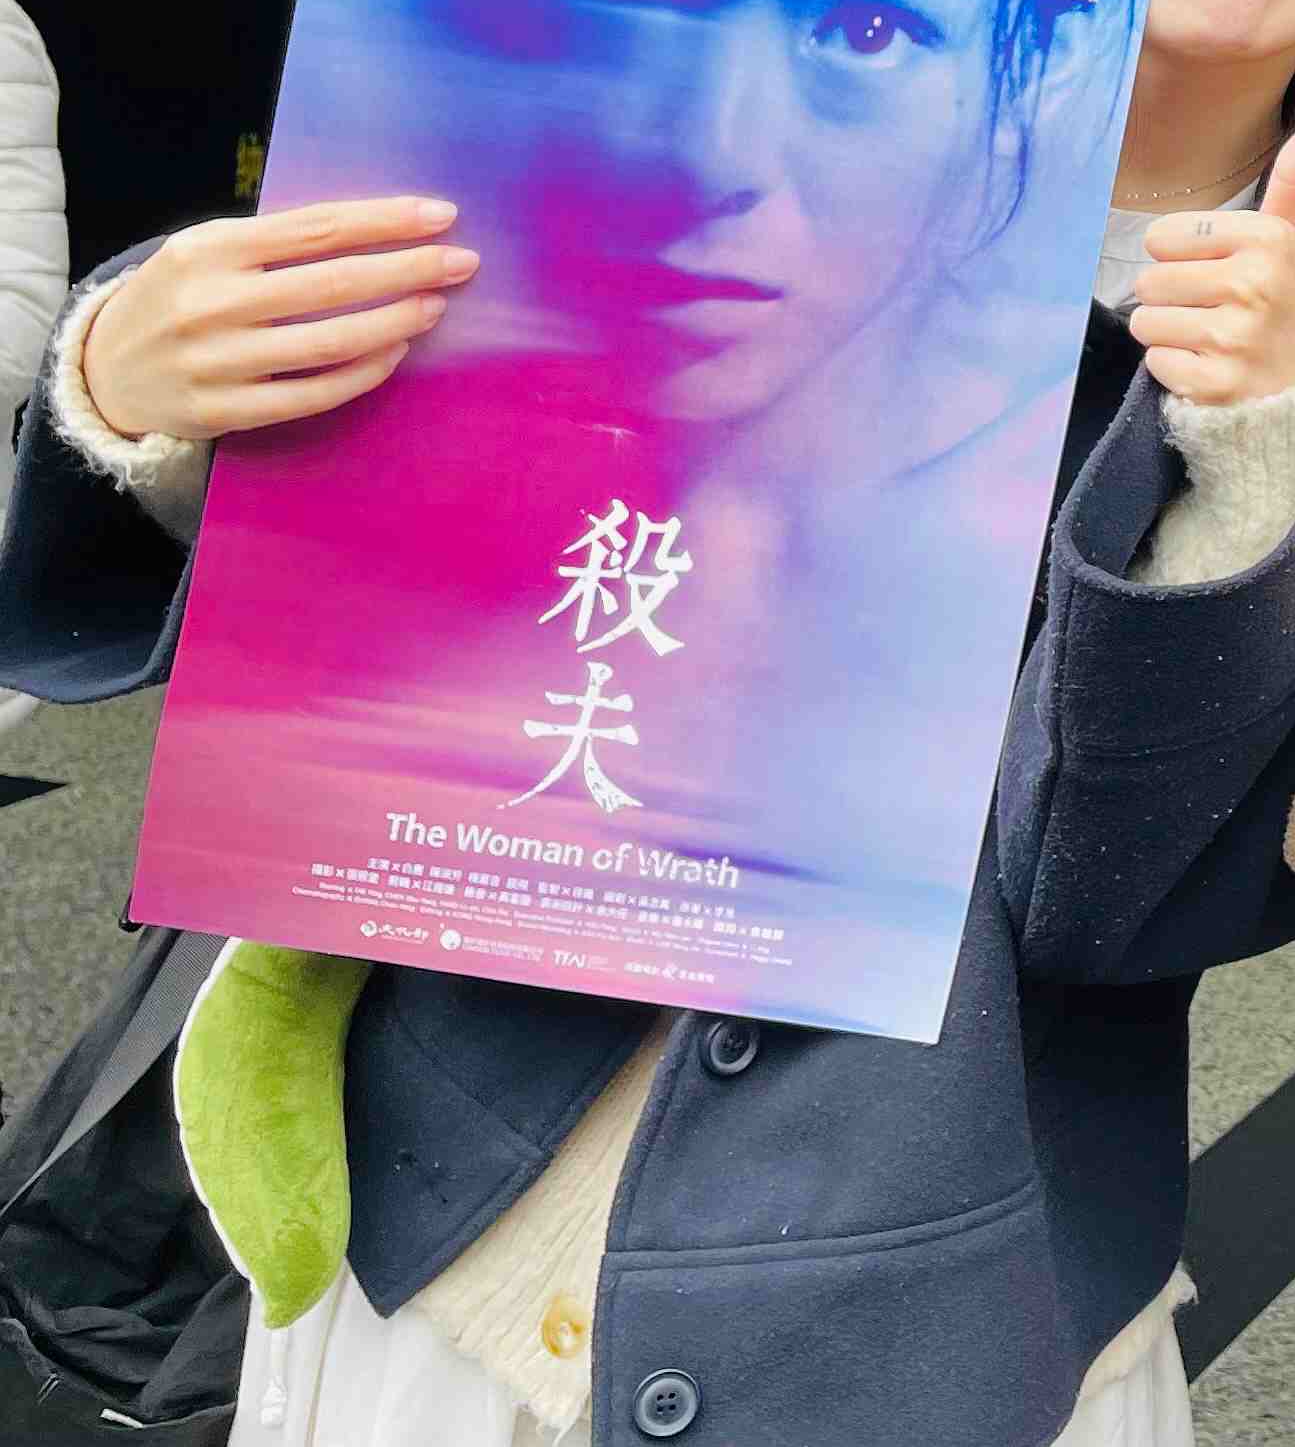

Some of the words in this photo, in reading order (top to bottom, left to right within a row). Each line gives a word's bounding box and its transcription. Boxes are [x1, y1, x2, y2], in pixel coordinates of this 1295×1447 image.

[498, 498, 693, 813] 殺夫
[386, 812, 448, 848] The
[456, 822, 585, 868] Woman
[591, 843, 634, 872] of
[638, 846, 740, 889] Wrath
